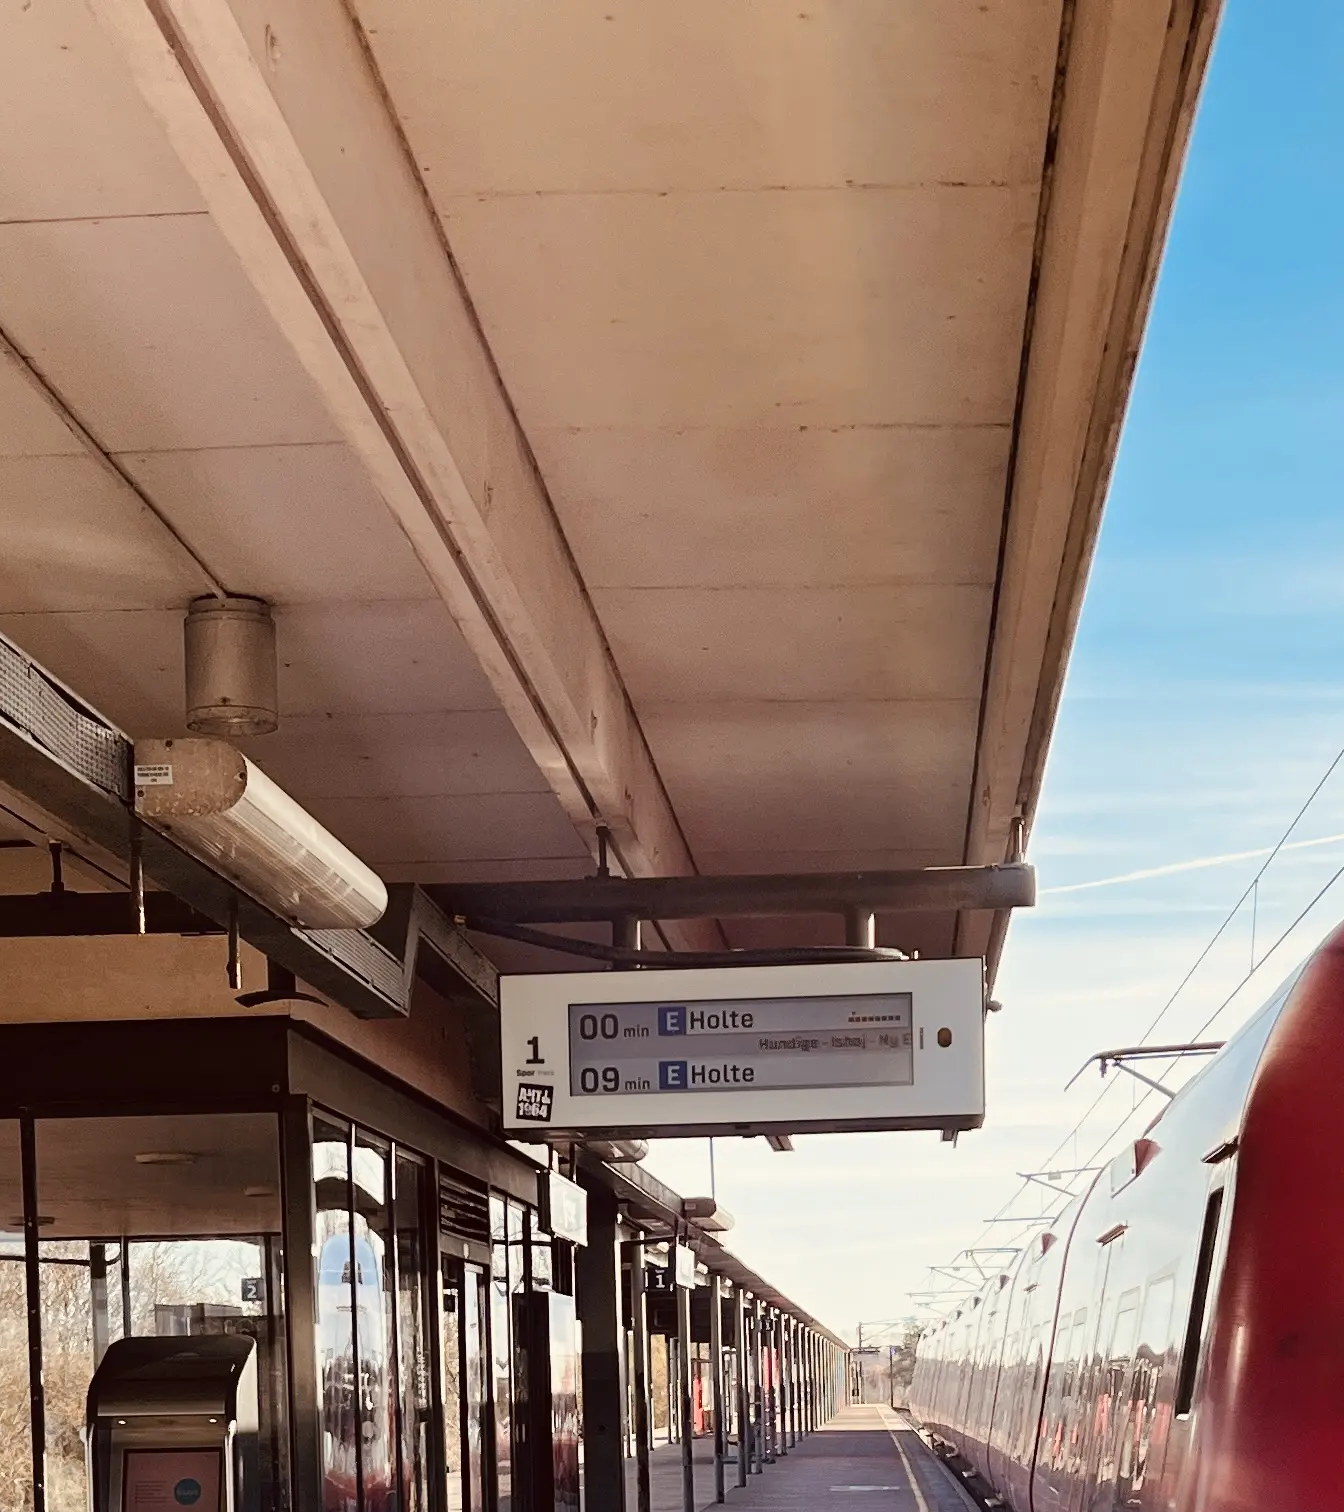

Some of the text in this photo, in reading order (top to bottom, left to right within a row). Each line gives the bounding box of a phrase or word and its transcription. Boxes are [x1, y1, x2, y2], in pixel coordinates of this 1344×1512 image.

[580, 1014, 649, 1040] 00 min
[665, 1010, 754, 1031] E Holte
[526, 1036, 545, 1065] 1
[581, 1067, 651, 1093] 09 min
[667, 1064, 755, 1085] E Holte
[518, 1102, 548, 1118] 1964
[247, 1284, 257, 1299] 2
[656, 1274, 665, 1288] 1
